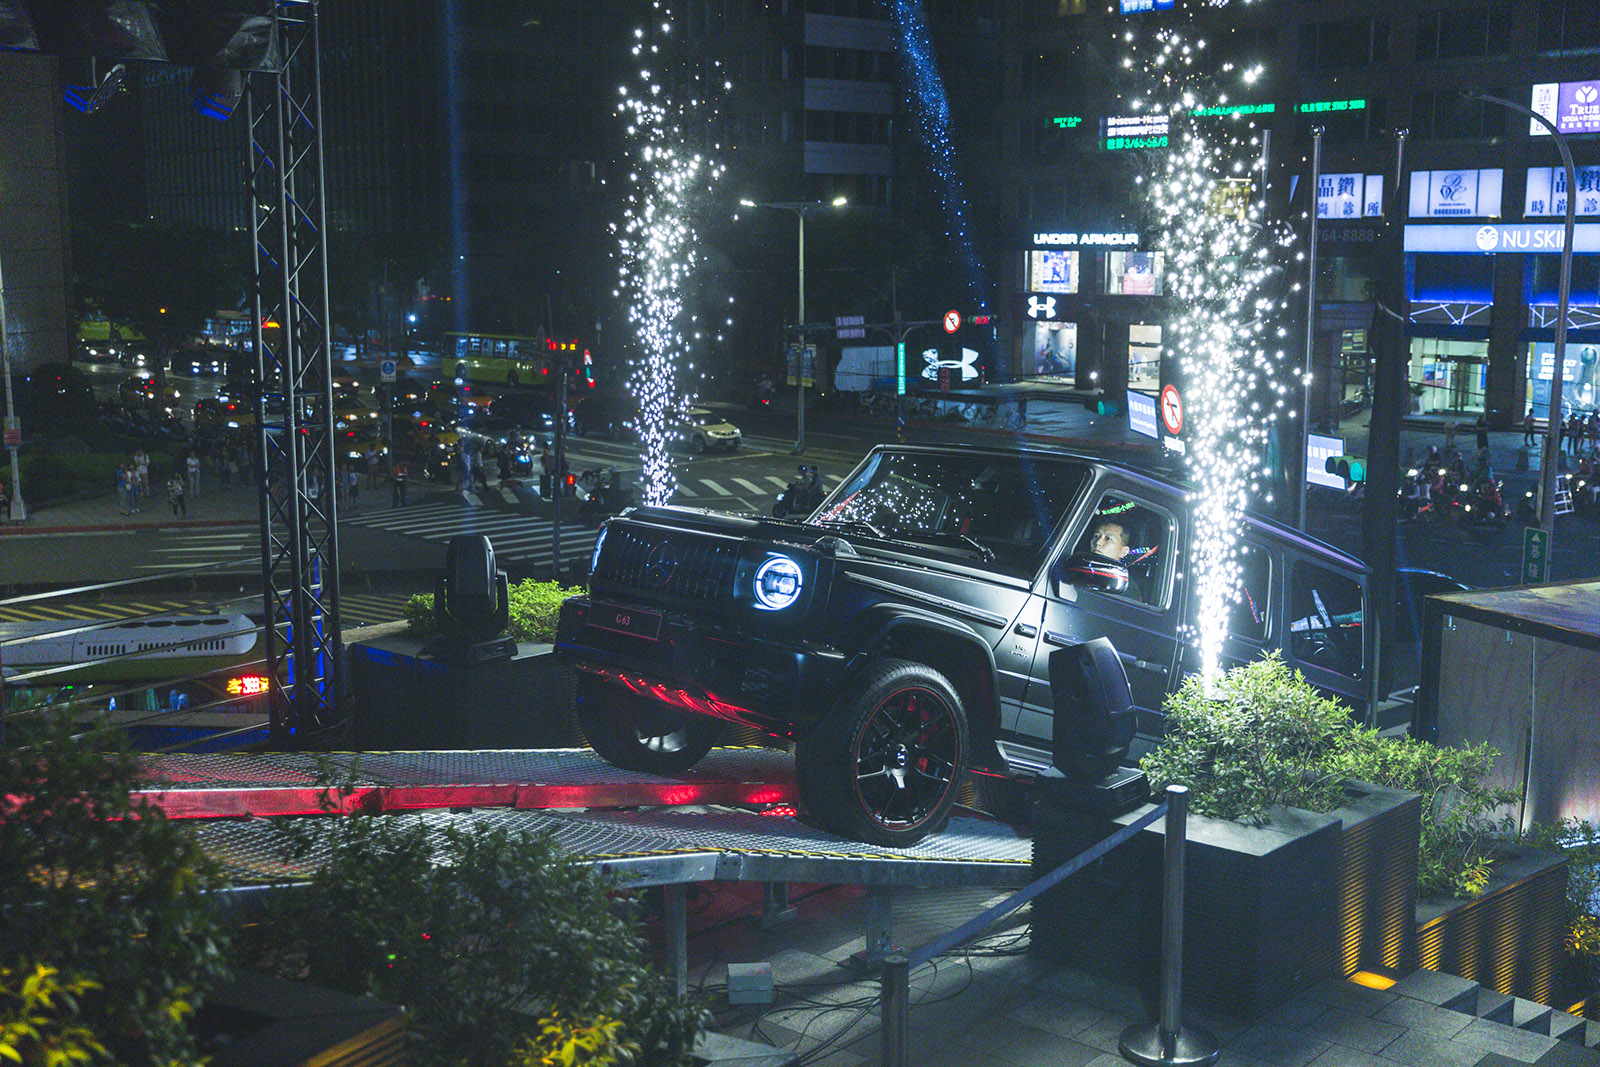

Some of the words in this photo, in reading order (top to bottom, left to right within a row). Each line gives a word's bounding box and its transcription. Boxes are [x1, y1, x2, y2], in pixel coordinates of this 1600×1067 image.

[1034, 233, 1078, 245] UNDER
[1080, 233, 1139, 245] ARMOUR
[1502, 230, 1530, 248] NU
[616, 614, 622, 624] G
[622, 615, 631, 626] 63
